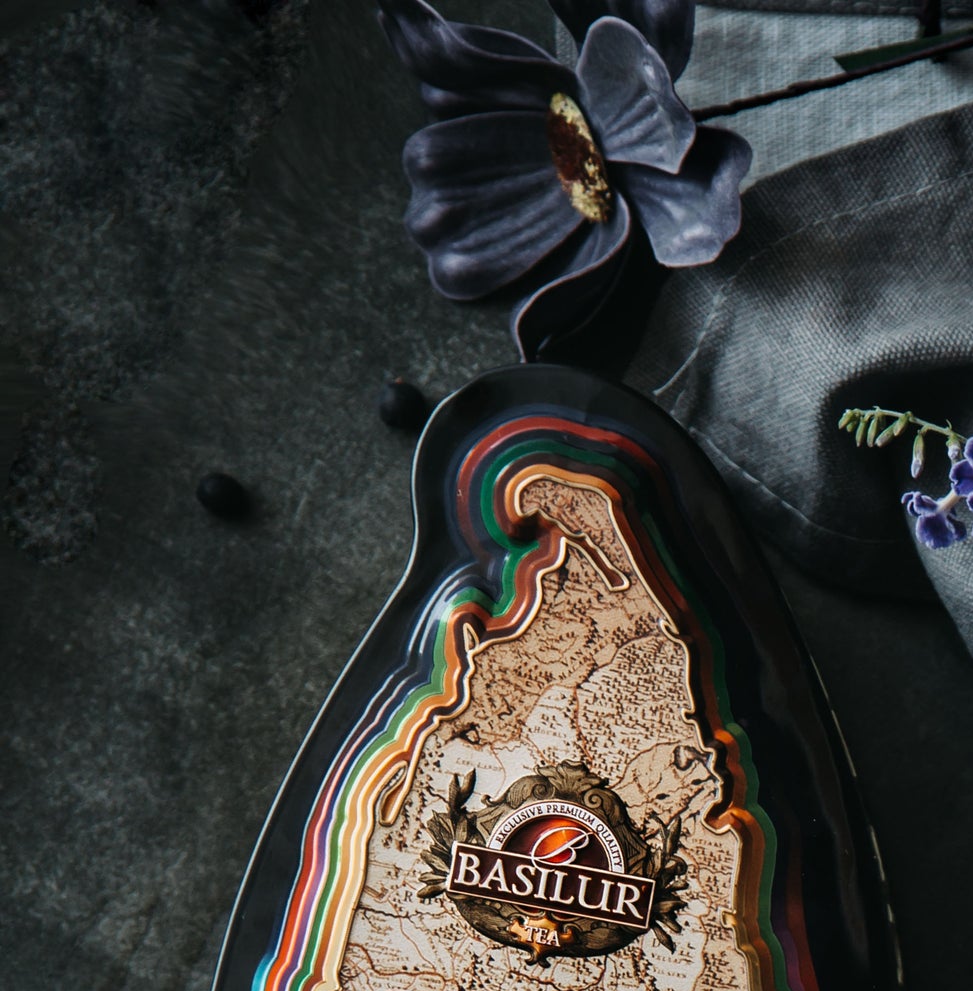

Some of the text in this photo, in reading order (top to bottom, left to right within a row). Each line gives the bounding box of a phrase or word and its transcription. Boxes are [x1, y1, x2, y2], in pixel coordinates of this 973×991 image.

[495, 804, 623, 868] EXCLUSIVE PREMIUM QUALITY
[454, 852, 643, 919] BASILUR
[525, 925, 560, 947] TEA
